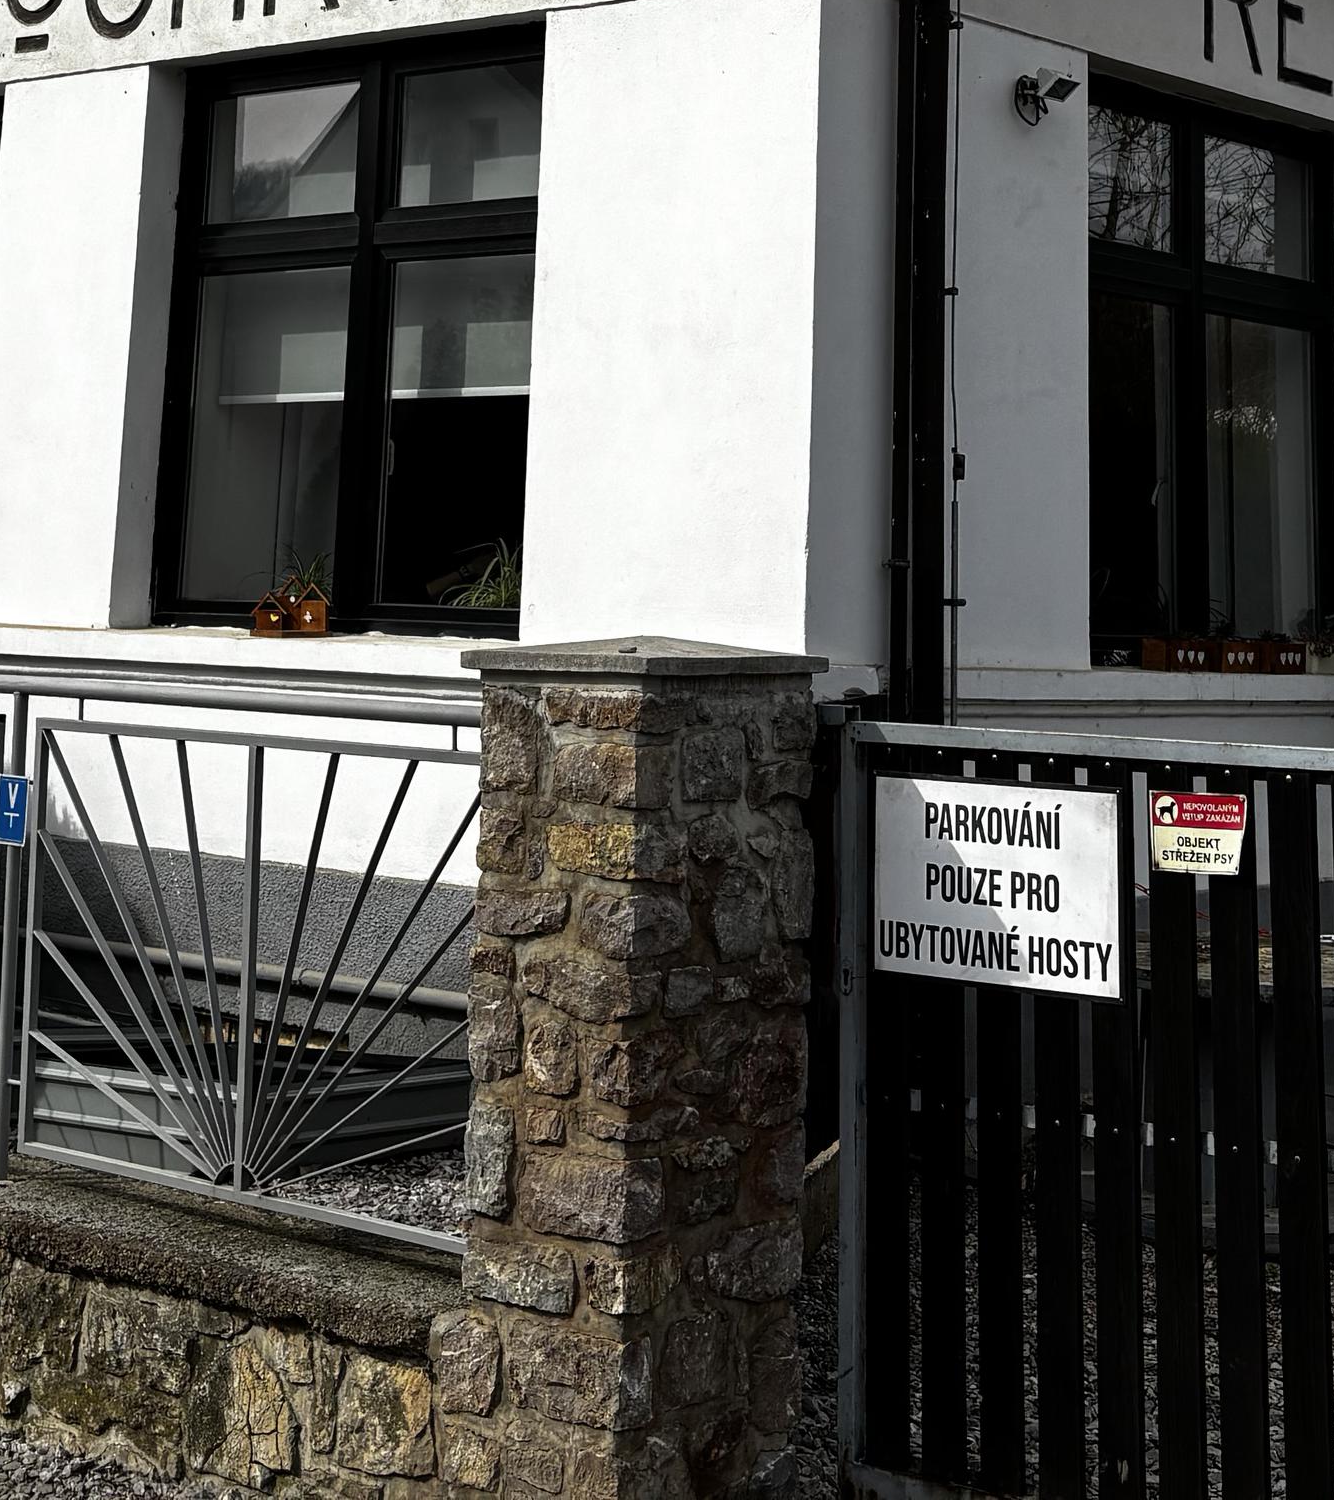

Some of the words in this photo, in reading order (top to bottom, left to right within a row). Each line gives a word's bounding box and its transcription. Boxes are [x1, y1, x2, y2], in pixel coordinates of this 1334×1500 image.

[8, 783, 19, 809] V
[1182, 813, 1204, 821] VSTUP
[1183, 802, 1238, 812] NEPOVOLANÝM
[924, 800, 1063, 851] PARKOVÁNÍ
[1177, 836, 1221, 850] OBJEKT
[1162, 849, 1210, 863] STŘEŽEN
[1213, 853, 1234, 865] PSY
[925, 862, 1003, 908] POUZE
[1010, 870, 1060, 914] PRO
[879, 918, 1020, 973] UBYTOVANÉ
[1027, 934, 1113, 983] HOSTY
